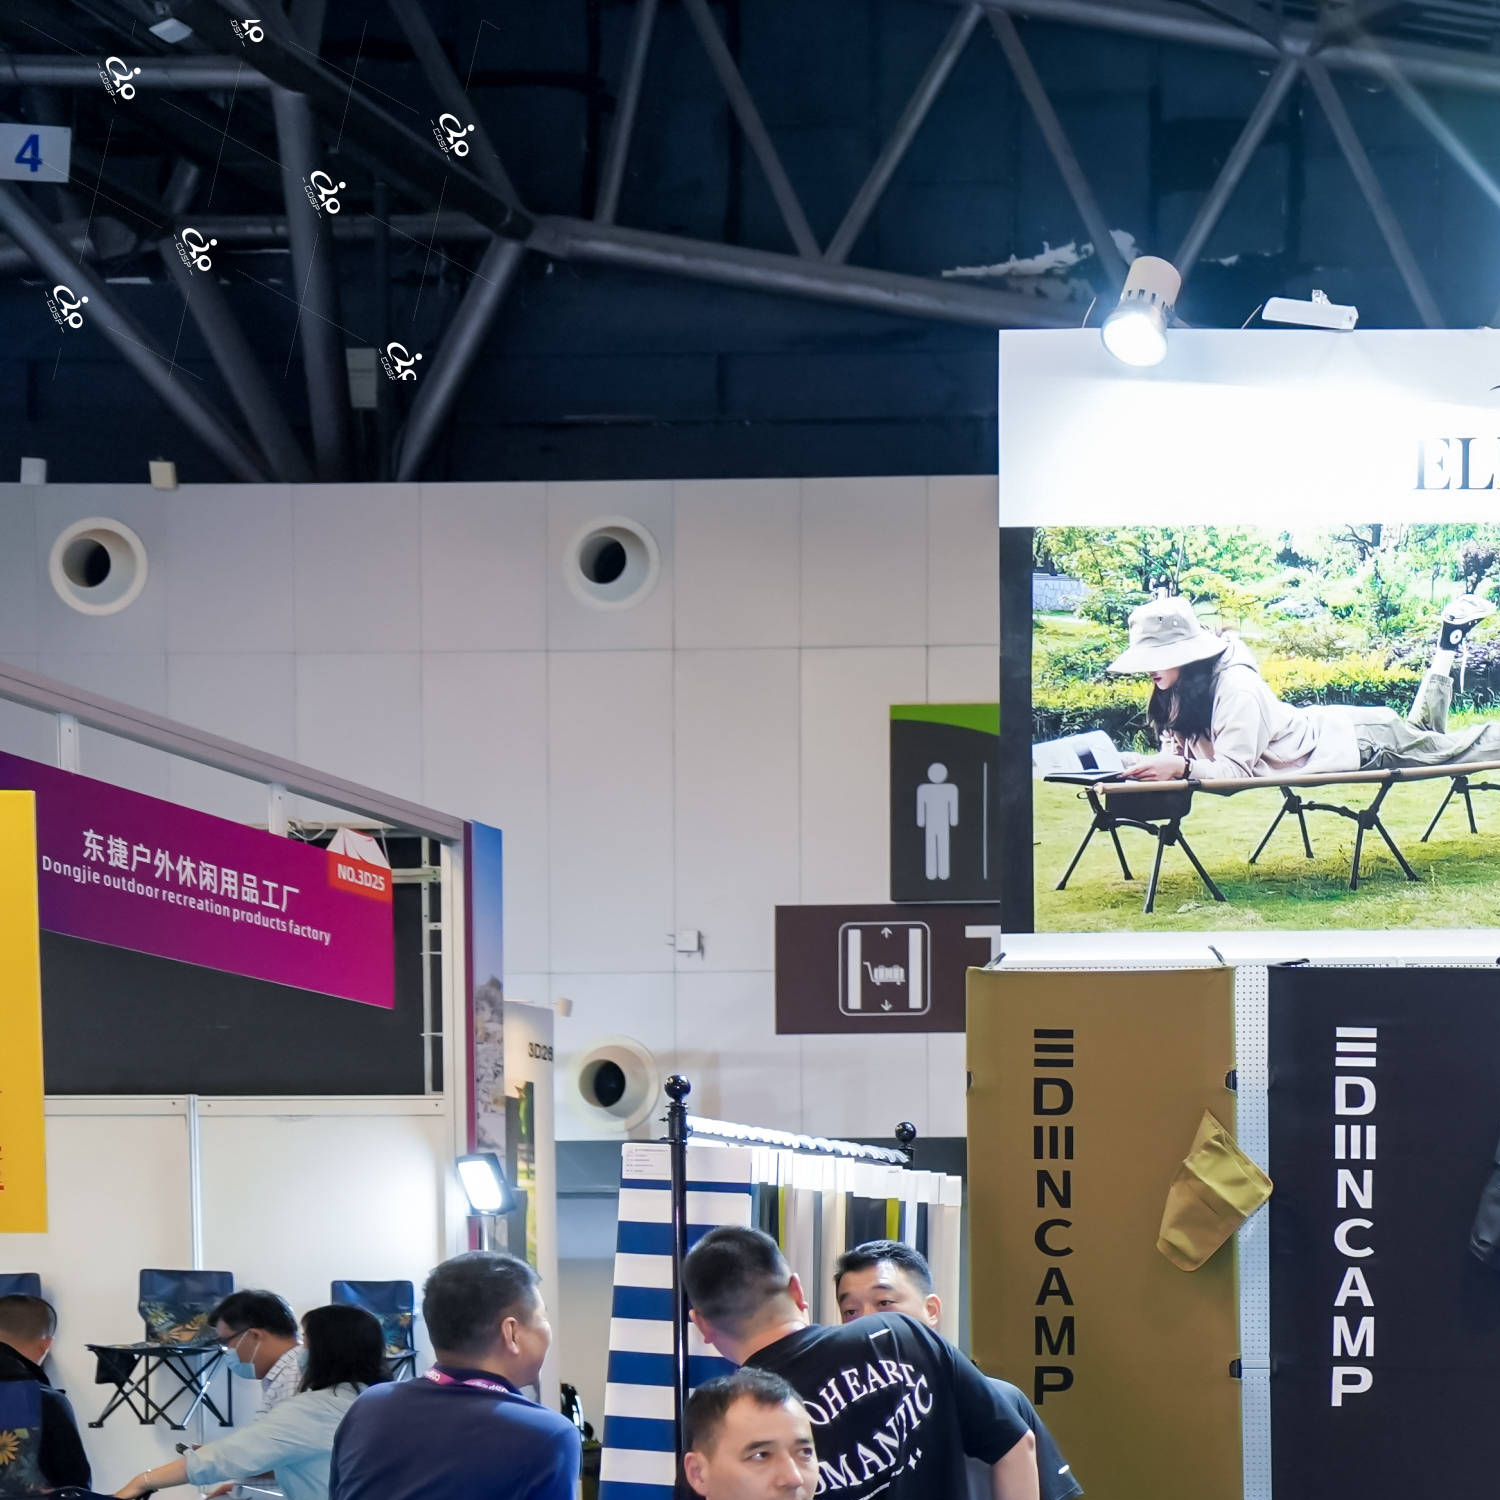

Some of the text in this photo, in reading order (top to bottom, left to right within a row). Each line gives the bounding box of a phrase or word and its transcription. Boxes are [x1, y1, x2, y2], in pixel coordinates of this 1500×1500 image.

[14, 133, 43, 173] 4
[42, 855, 332, 946] Dongjie outdoor recreation products factory
[82, 828, 300, 913] 东捷户外休闲用品工厂
[337, 862, 386, 892] NO.3D25
